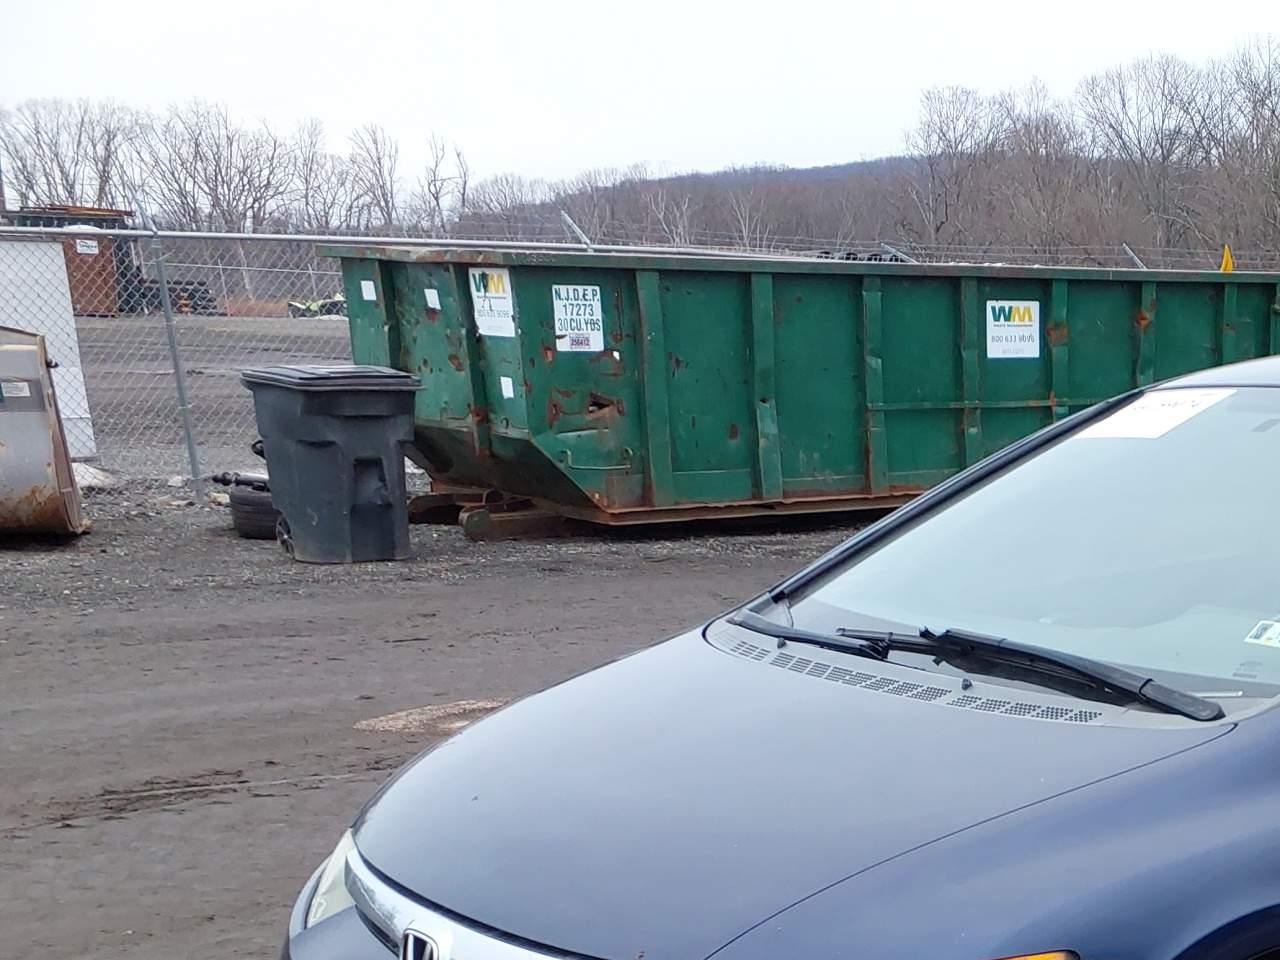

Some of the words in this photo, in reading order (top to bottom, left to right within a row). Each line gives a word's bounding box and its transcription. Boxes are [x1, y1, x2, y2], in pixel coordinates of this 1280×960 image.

[472, 271, 506, 293] WM
[554, 287, 600, 302] N.J.D.E.P.
[562, 303, 594, 317] 17273
[991, 306, 1032, 321] WM
